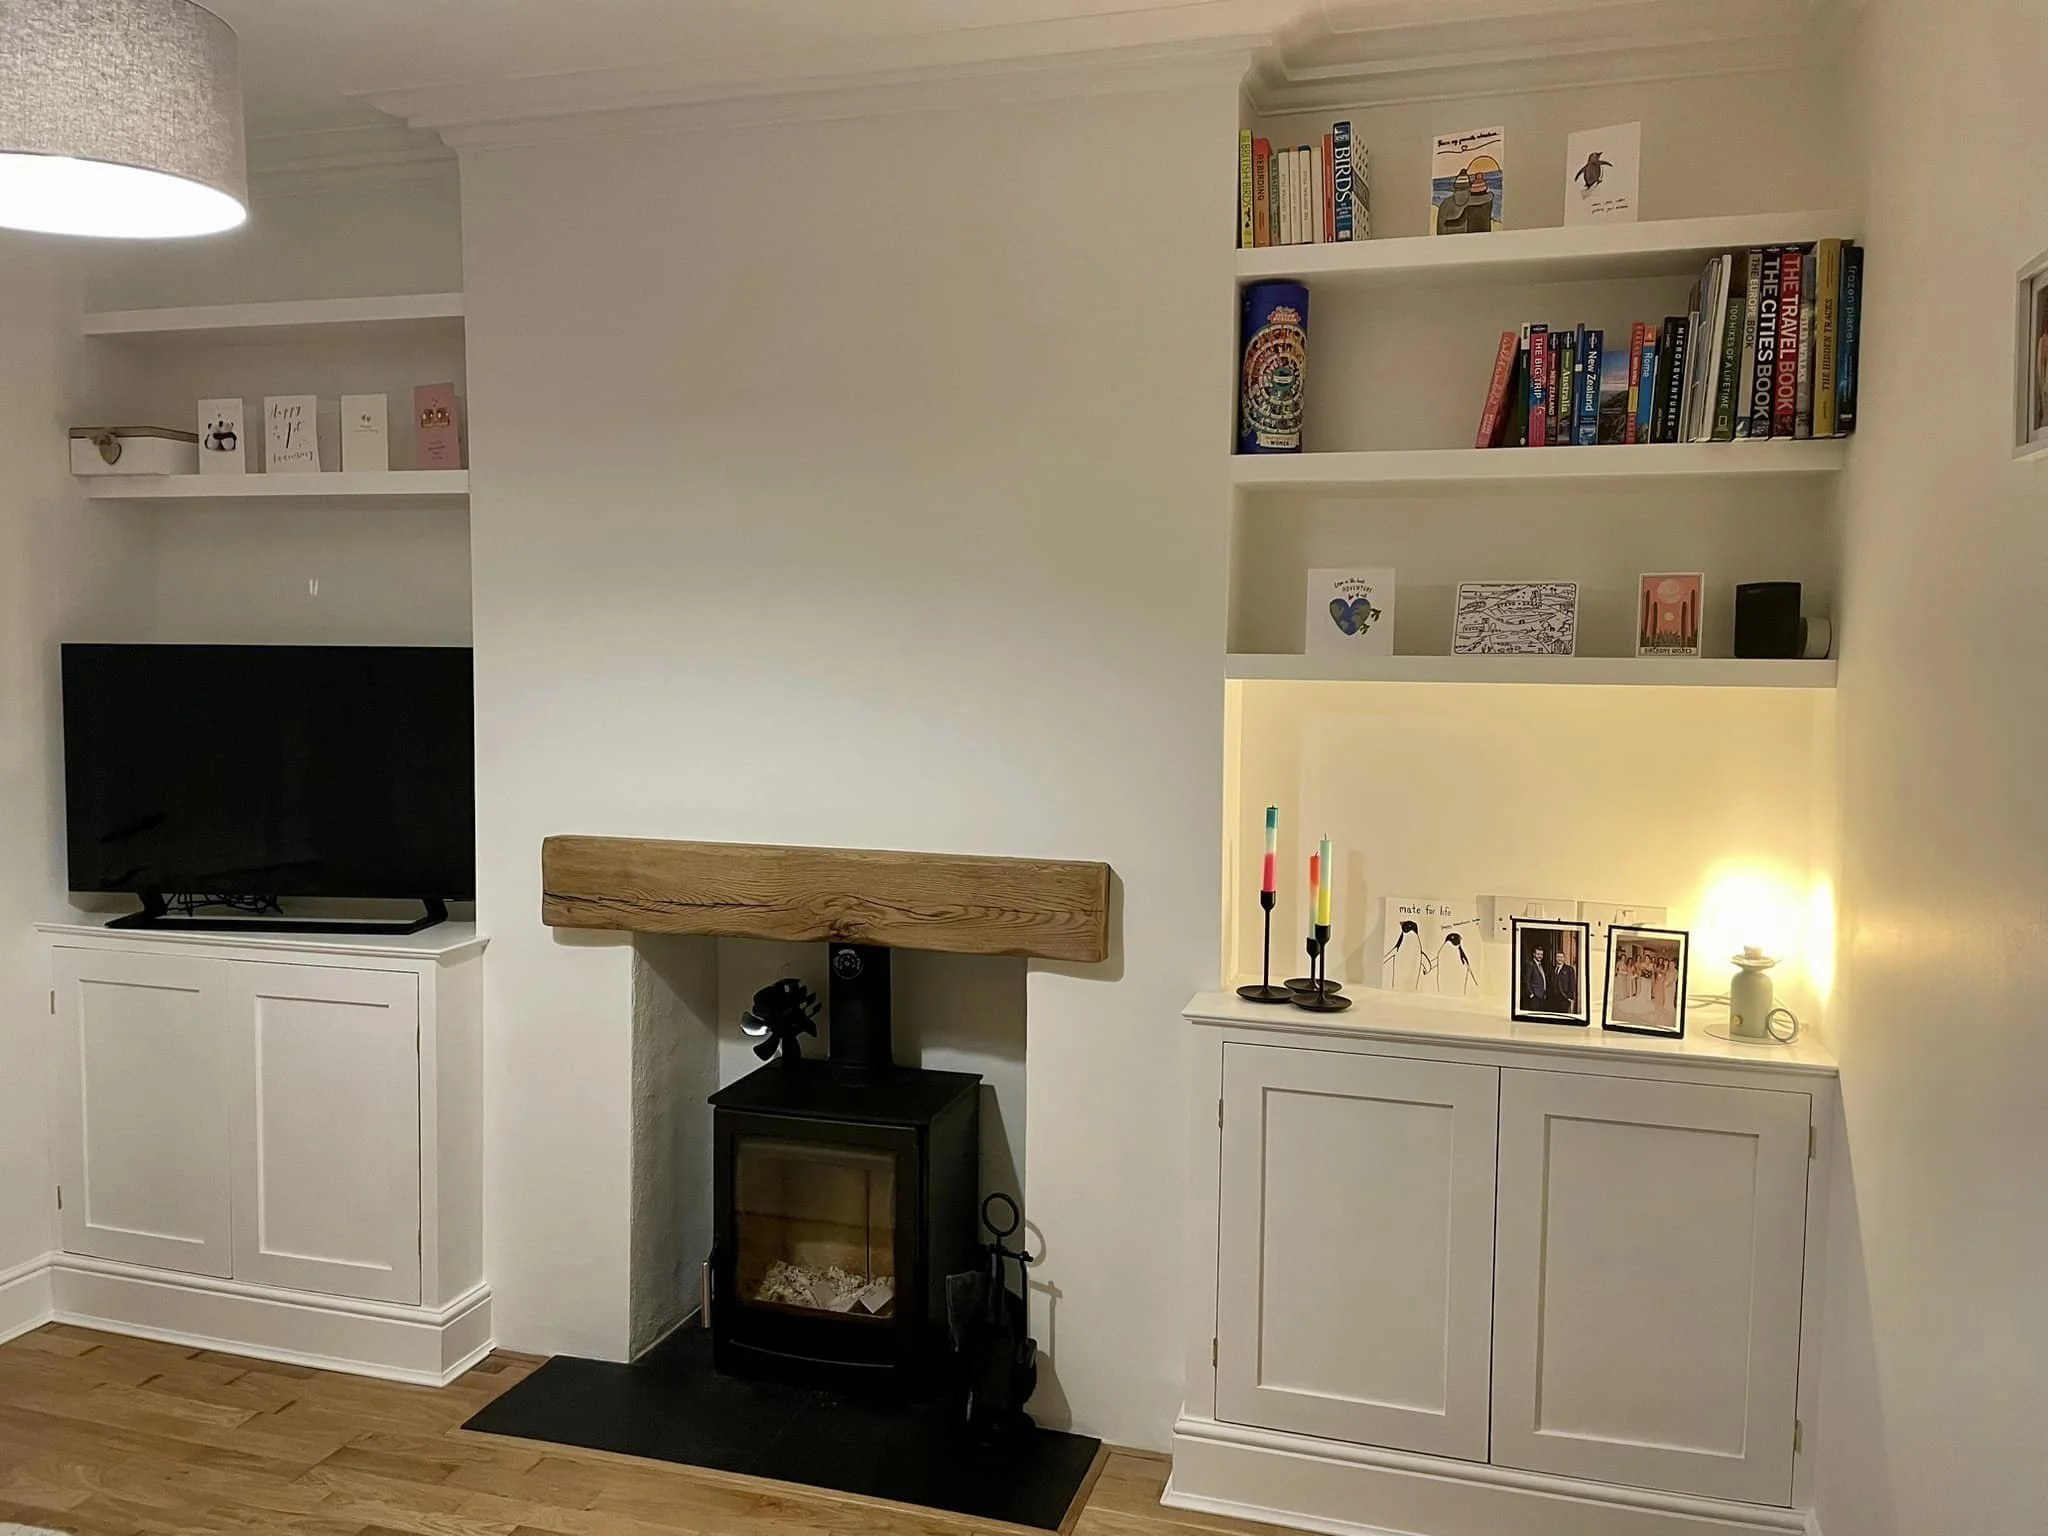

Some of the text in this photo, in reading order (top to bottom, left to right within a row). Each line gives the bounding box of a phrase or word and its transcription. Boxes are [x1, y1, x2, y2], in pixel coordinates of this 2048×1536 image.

[1241, 143, 1252, 208] BRITISH BIRDS
[1256, 153, 1265, 201] REBIRDING
[1334, 146, 1352, 203] BIRDS
[1745, 256, 1760, 349] THE EUROPE BOOK
[1846, 264, 1857, 303] frozen
[1753, 257, 1780, 419] THE CITIES BOOK
[1777, 256, 1801, 411] THE TRAVEL BOOK
[1845, 306, 1856, 344] planet
[1533, 336, 1543, 399] THE BIG TRIP
[1642, 352, 1653, 377] Rome
[1667, 327, 1685, 427] MICROADVENTURES
[1720, 303, 1739, 409] 100 HIKES OF A LIFETIME
[1798, 342, 1808, 384] WALKS
[1823, 335, 1832, 372] HIDDEN
[1548, 386, 1556, 416] ZEALAND
[1560, 368, 1571, 413] Australia
[1584, 351, 1597, 412] New Zealand
[1822, 372, 1832, 391] THE
[1399, 904, 1453, 917] mate for life
